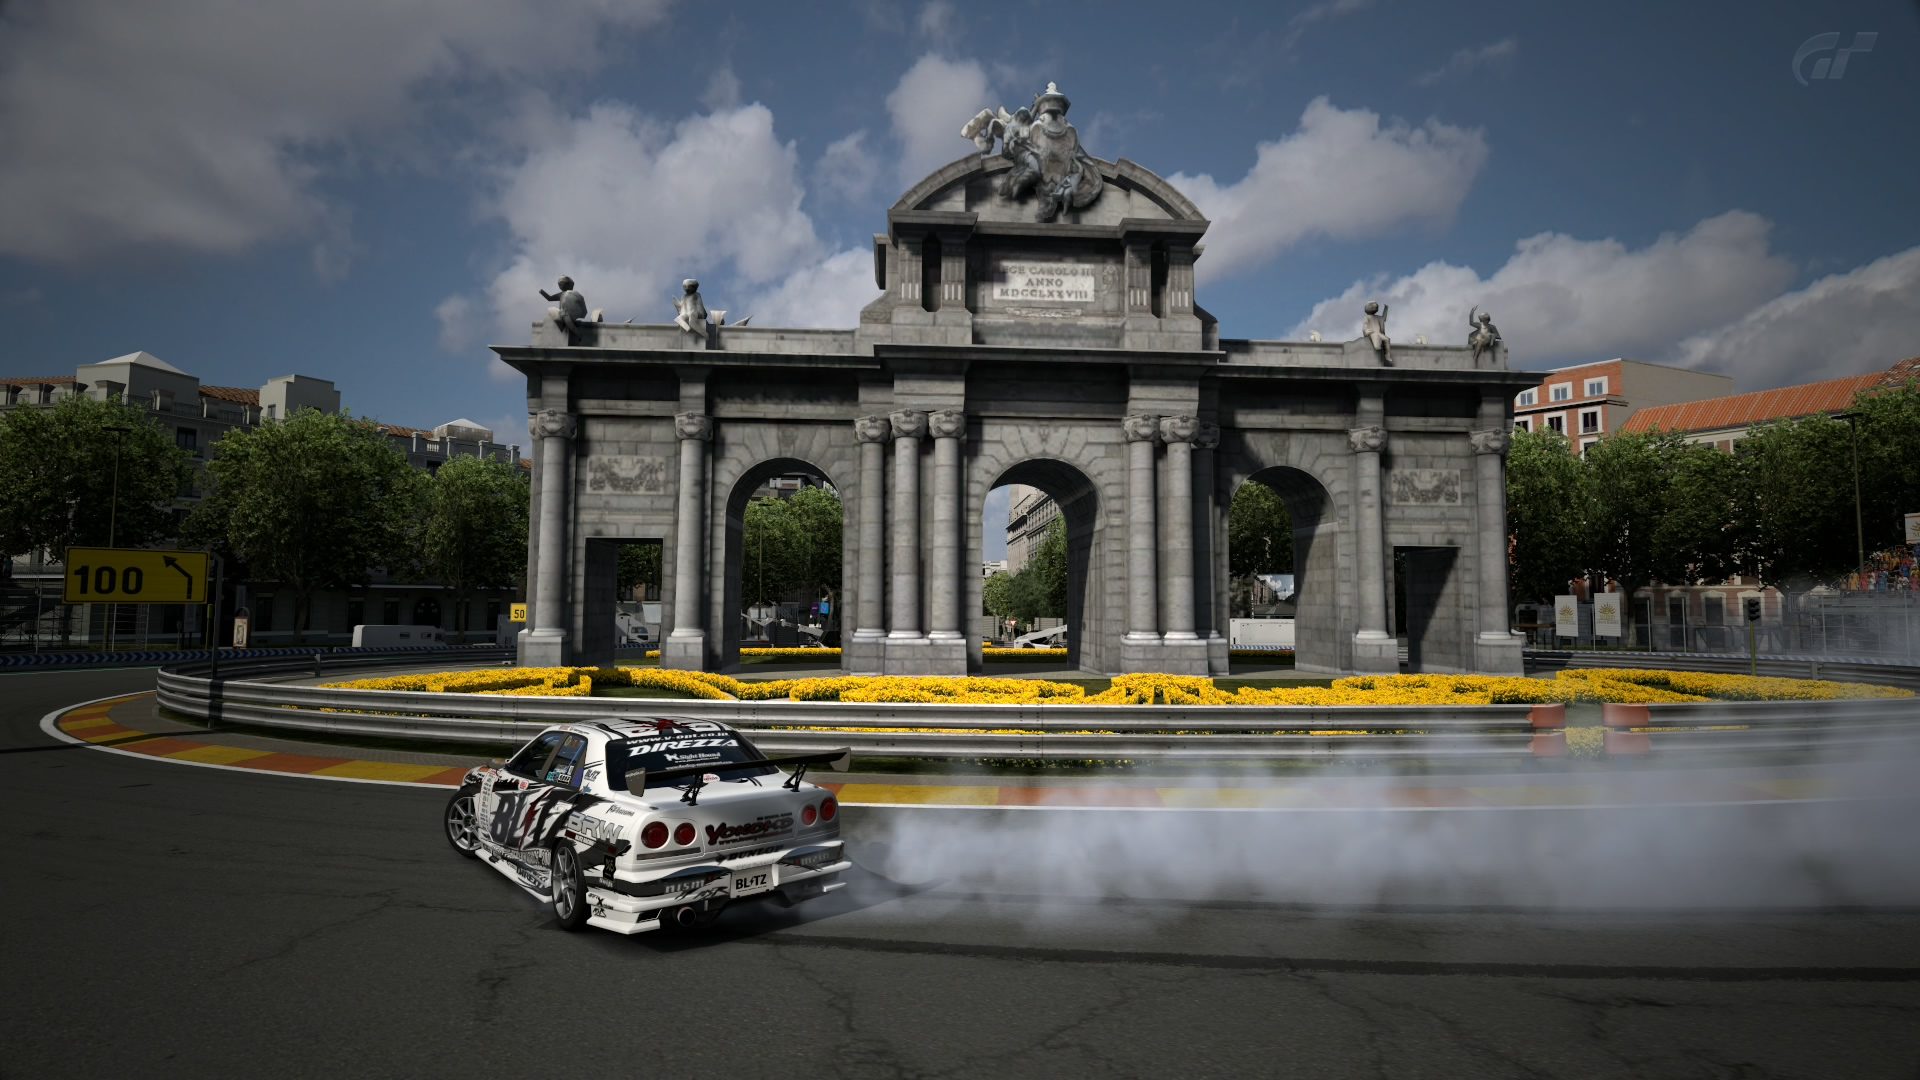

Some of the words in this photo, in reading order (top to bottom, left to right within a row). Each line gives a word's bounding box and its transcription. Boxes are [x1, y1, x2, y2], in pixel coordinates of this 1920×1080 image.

[1025, 278, 1063, 287] ANNO
[1000, 288, 1088, 299] MDCCLXXVIII
[74, 565, 144, 595] 100
[514, 609, 525, 619] 50
[626, 738, 740, 757] DIREZZA
[567, 811, 624, 845] BRW
[735, 873, 767, 890] BLITZ
